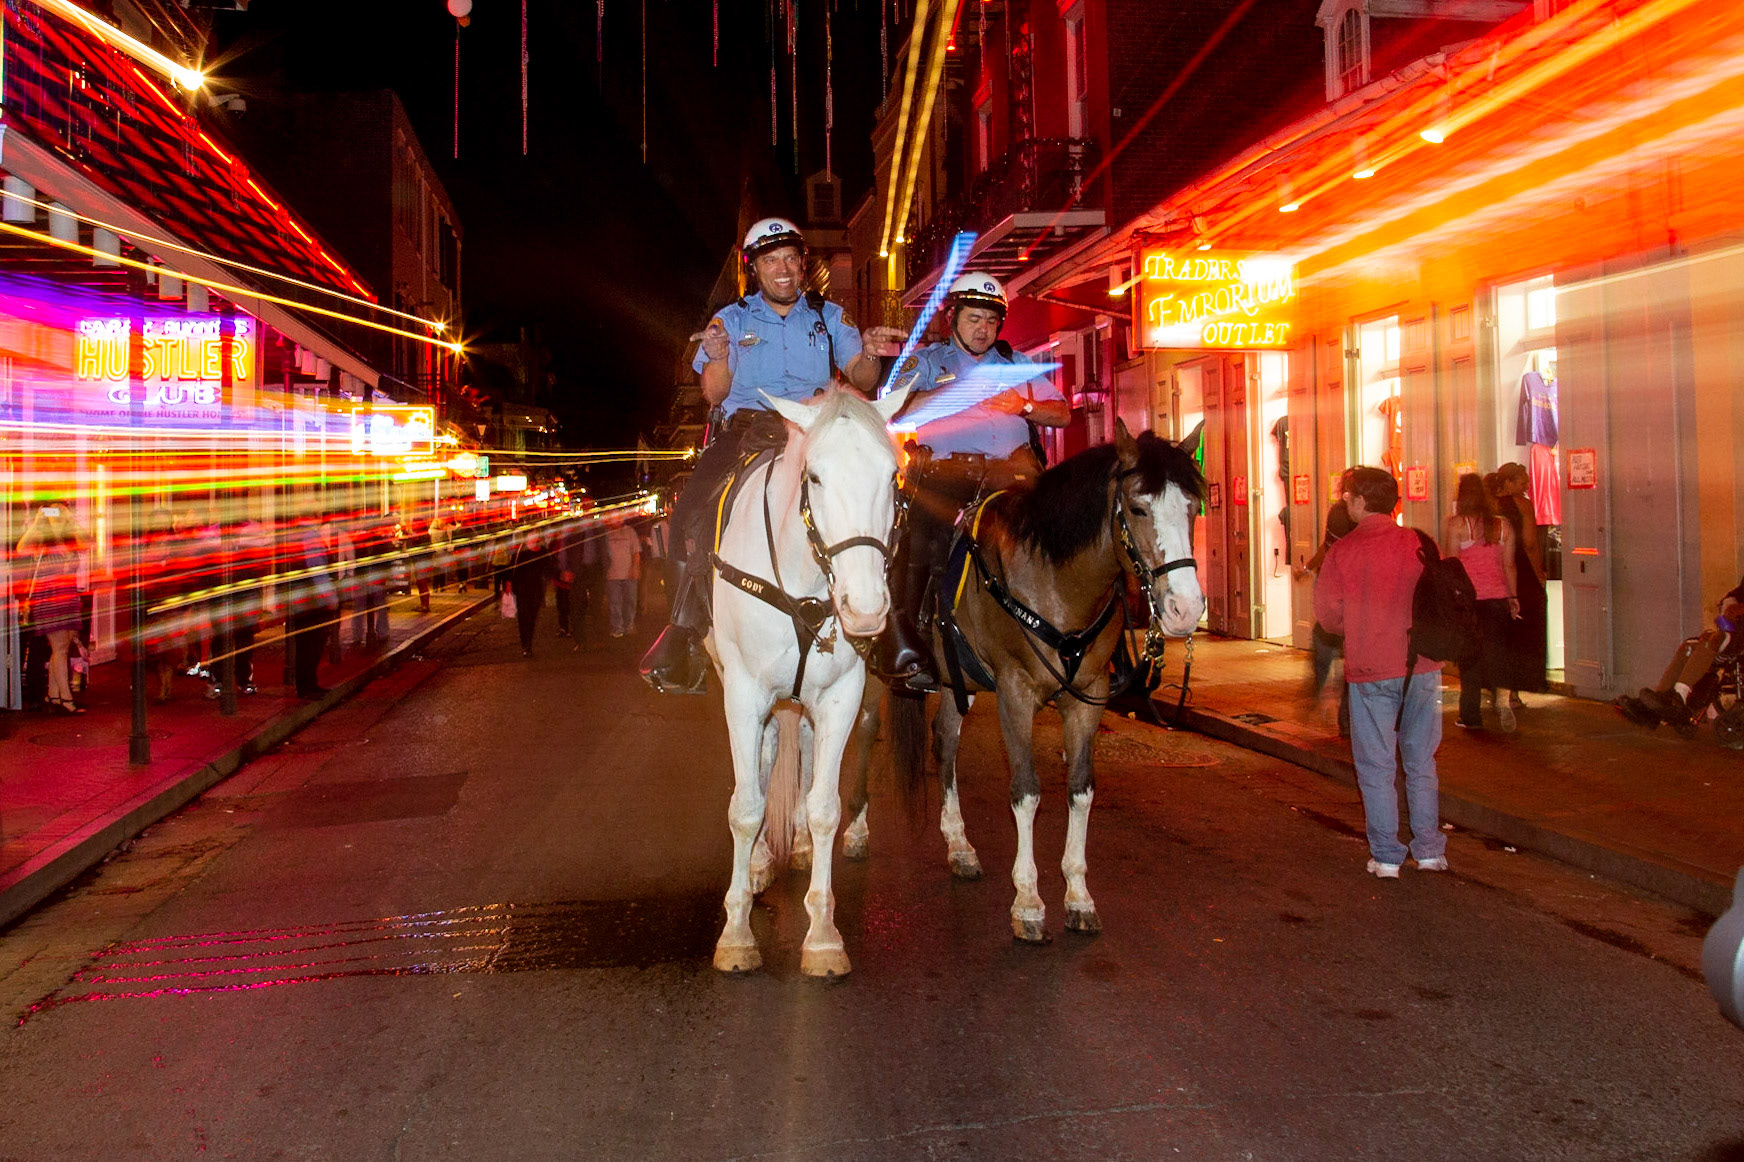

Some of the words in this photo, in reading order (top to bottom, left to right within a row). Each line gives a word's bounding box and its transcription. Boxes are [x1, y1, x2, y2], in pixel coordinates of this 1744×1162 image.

[1149, 273, 1296, 328] EMPORIUM
[1203, 322, 1289, 345] OUTLET
[78, 335, 248, 381] HUSTLER
[156, 410, 200, 418] HUSTLER
[741, 577, 764, 594] CODY
